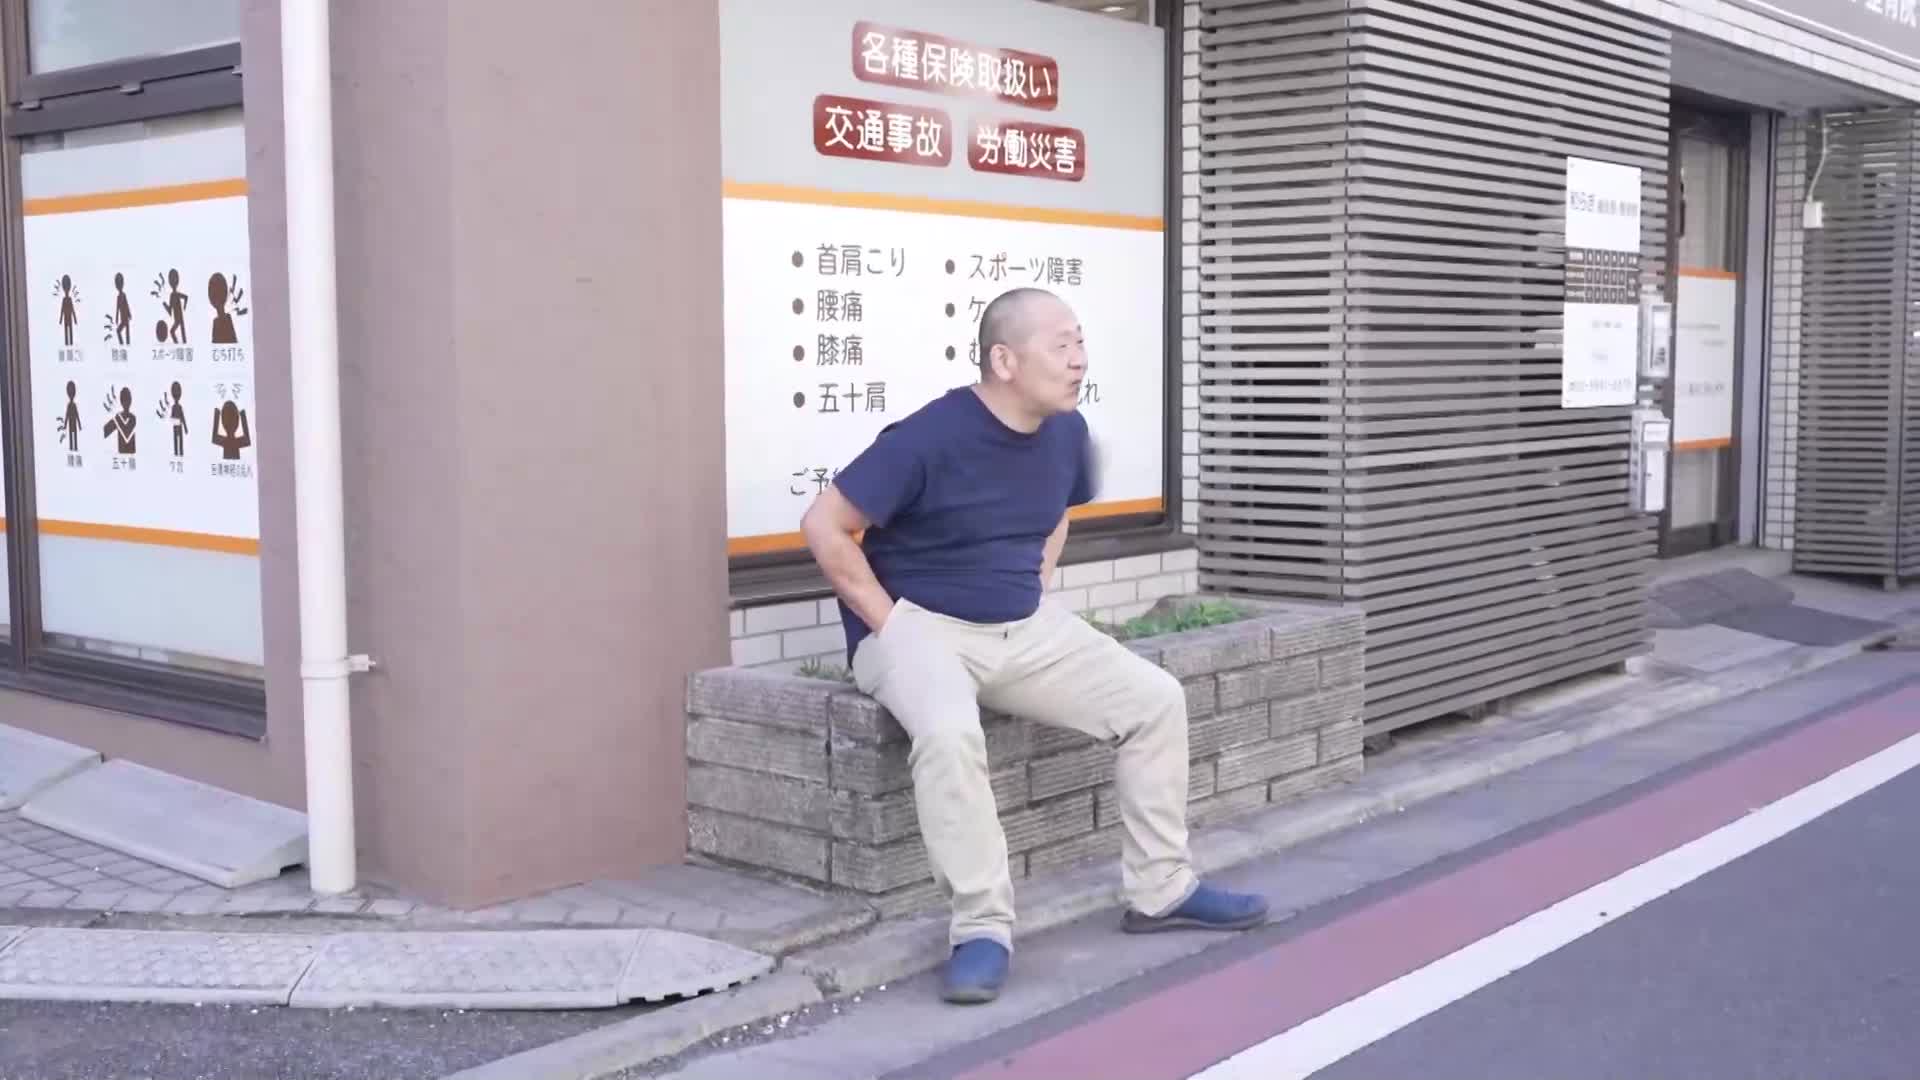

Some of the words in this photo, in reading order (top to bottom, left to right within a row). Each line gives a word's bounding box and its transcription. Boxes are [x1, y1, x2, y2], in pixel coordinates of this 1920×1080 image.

[860, 31, 1055, 99] 各種保険取扱い
[824, 104, 944, 159] 交通事故
[977, 126, 1078, 175] 労働災害
[817, 243, 907, 278] 首肩こり
[968, 252, 1084, 286] スポーツ障害
[816, 290, 864, 324] 腰痛
[816, 334, 864, 367] 膝痛
[817, 381, 887, 414] 五十肩
[789, 466, 836, 497] ご予
